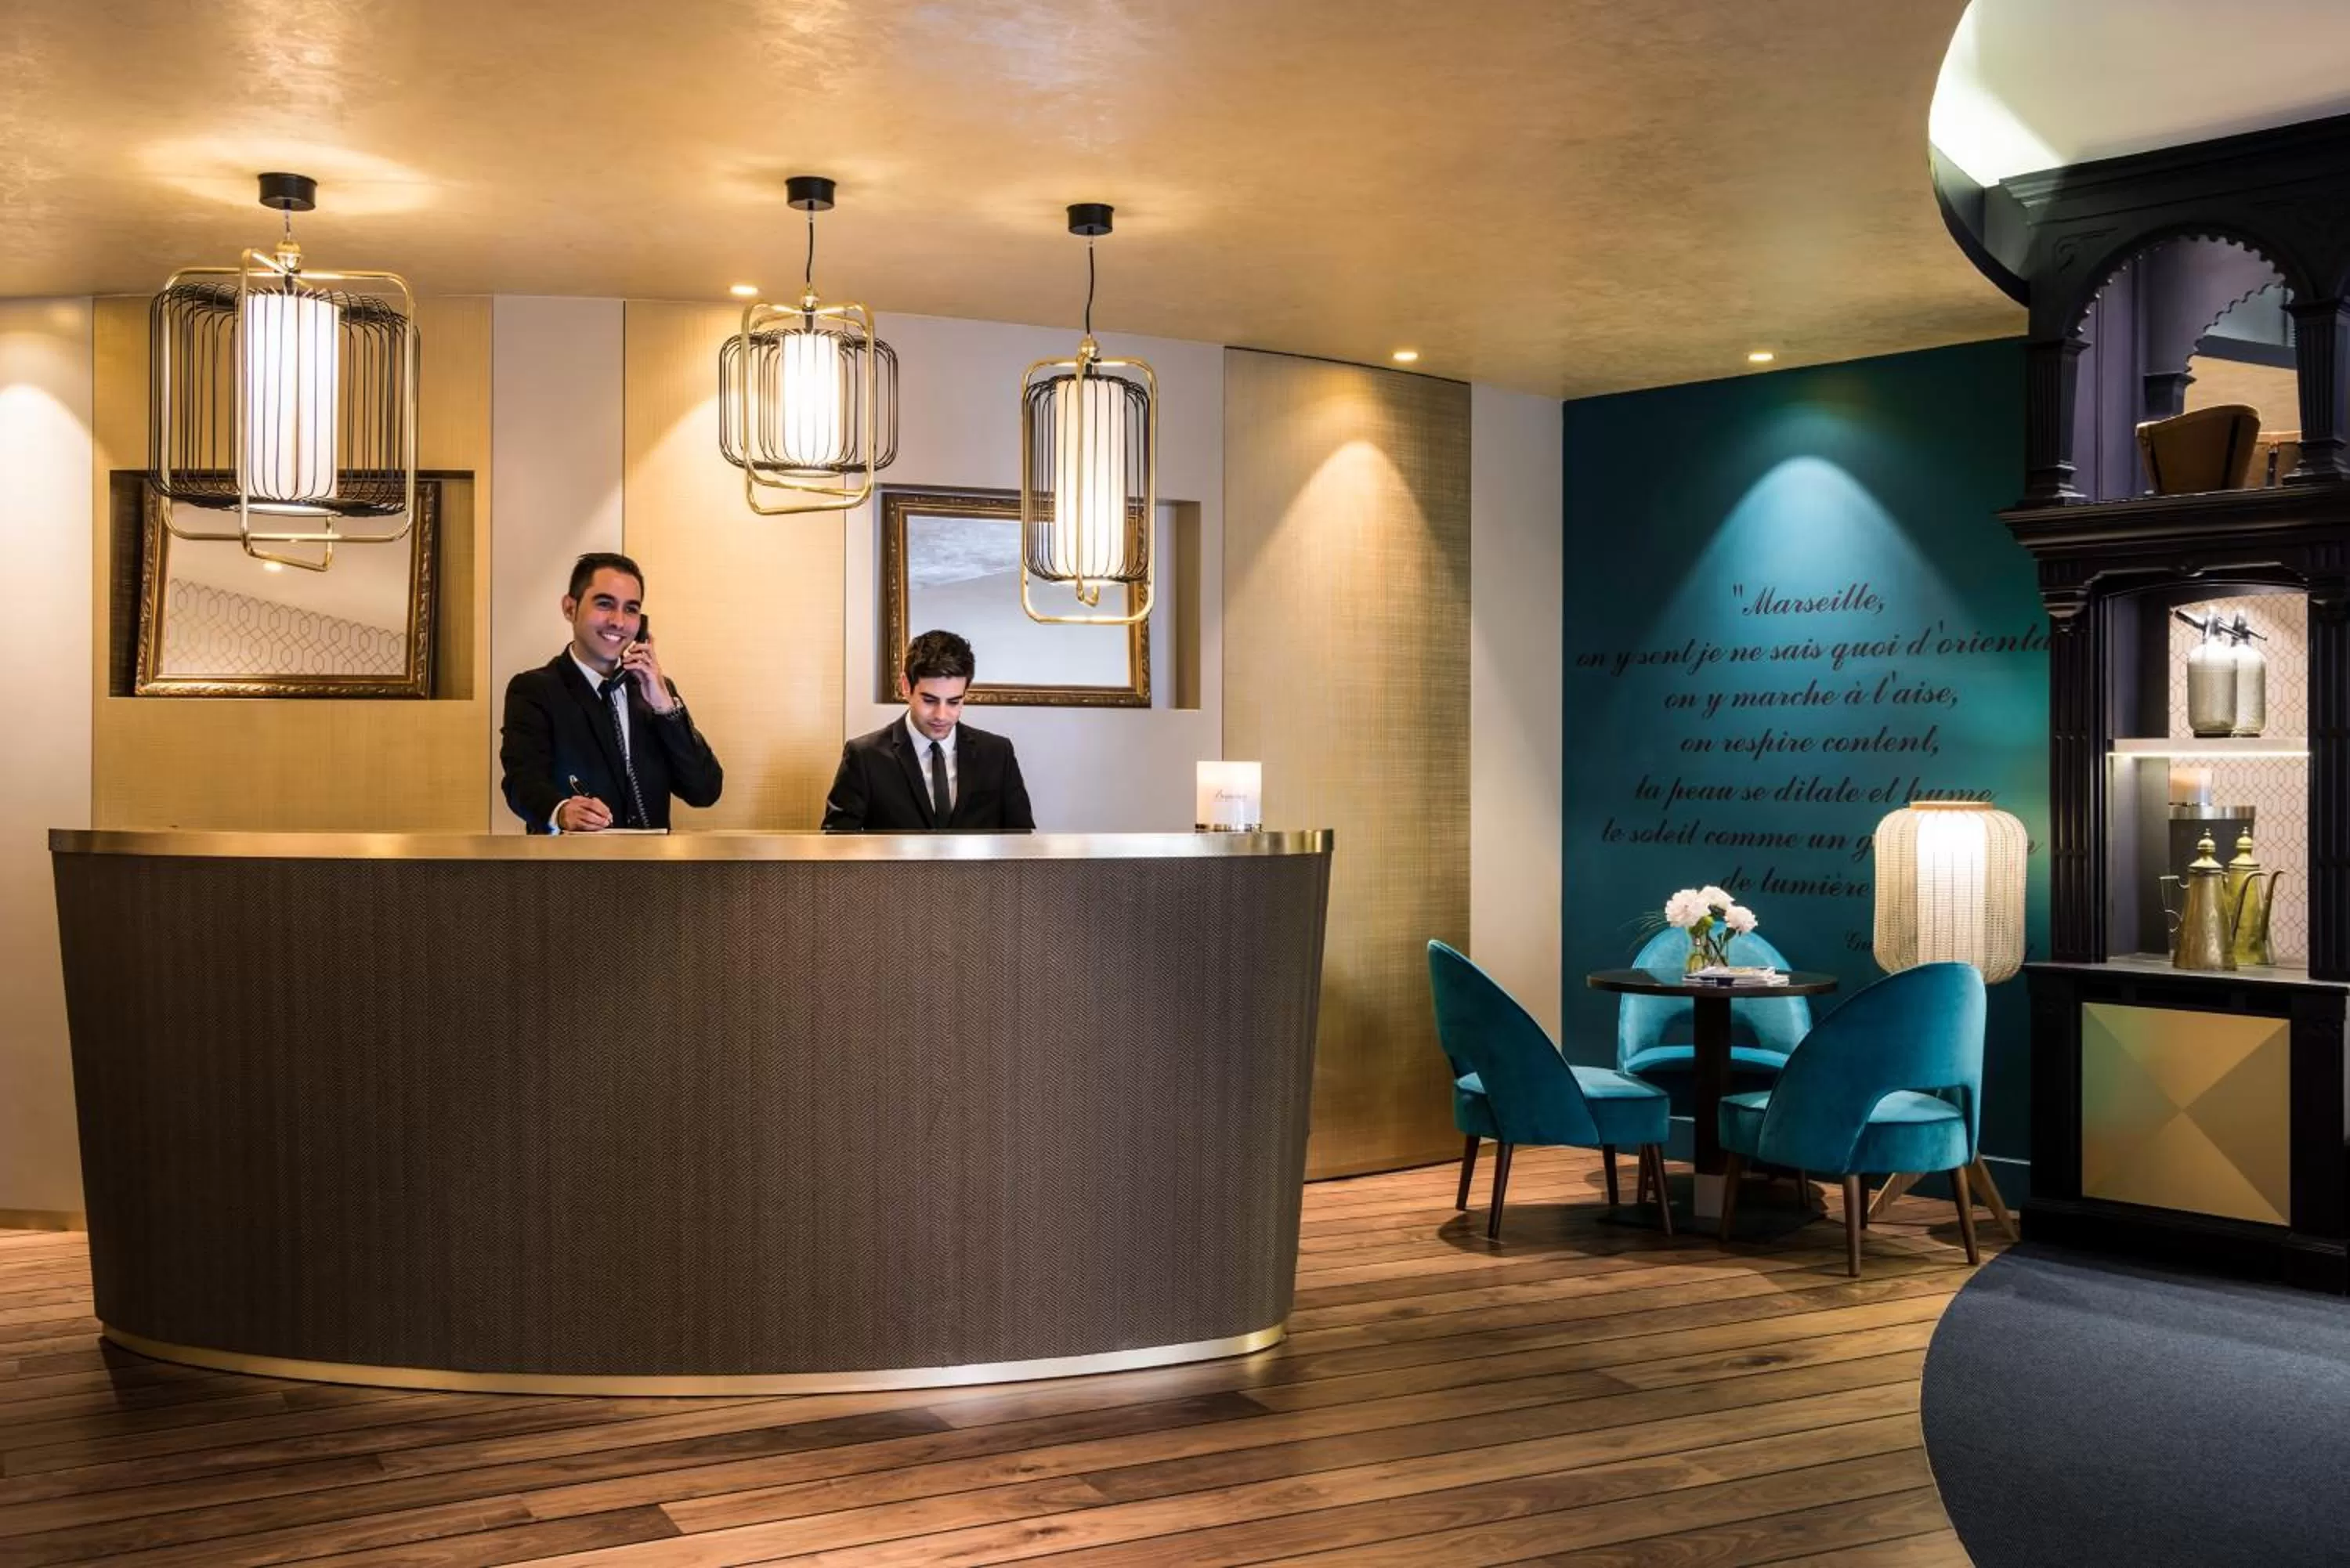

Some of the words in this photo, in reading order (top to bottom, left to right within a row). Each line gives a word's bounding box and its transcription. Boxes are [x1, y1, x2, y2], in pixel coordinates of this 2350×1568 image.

[1733, 583, 1885, 615] "Marseille,
[1576, 651, 1606, 667] on
[1611, 651, 1631, 677] y
[1636, 638, 1697, 665] sent
[1686, 642, 1725, 676] je
[1729, 645, 1765, 663] ne
[1770, 638, 1823, 660] sais
[1831, 634, 1901, 671] quoi
[1907, 620, 2050, 653] d'orienta
[1664, 692, 1702, 708] on
[1701, 692, 1728, 720] y
[1730, 677, 1841, 708] marche
[1844, 681, 1871, 706] à
[1872, 670, 1958, 710] l'aise,
[1680, 738, 1717, 752] on
[1722, 728, 1820, 761] respire
[1822, 725, 1940, 757] content,
[1635, 774, 1661, 800] la
[1661, 777, 1738, 811] peau
[1741, 786, 1770, 802] se
[1773, 775, 1869, 803] dilate
[1868, 776, 1902, 803] et
[1601, 816, 1626, 842] le
[1629, 819, 1701, 846] soleil
[1705, 830, 1799, 849] comme
[1806, 833, 1849, 850] un
[1719, 865, 1756, 891] de
[1760, 865, 1871, 899] lumière
